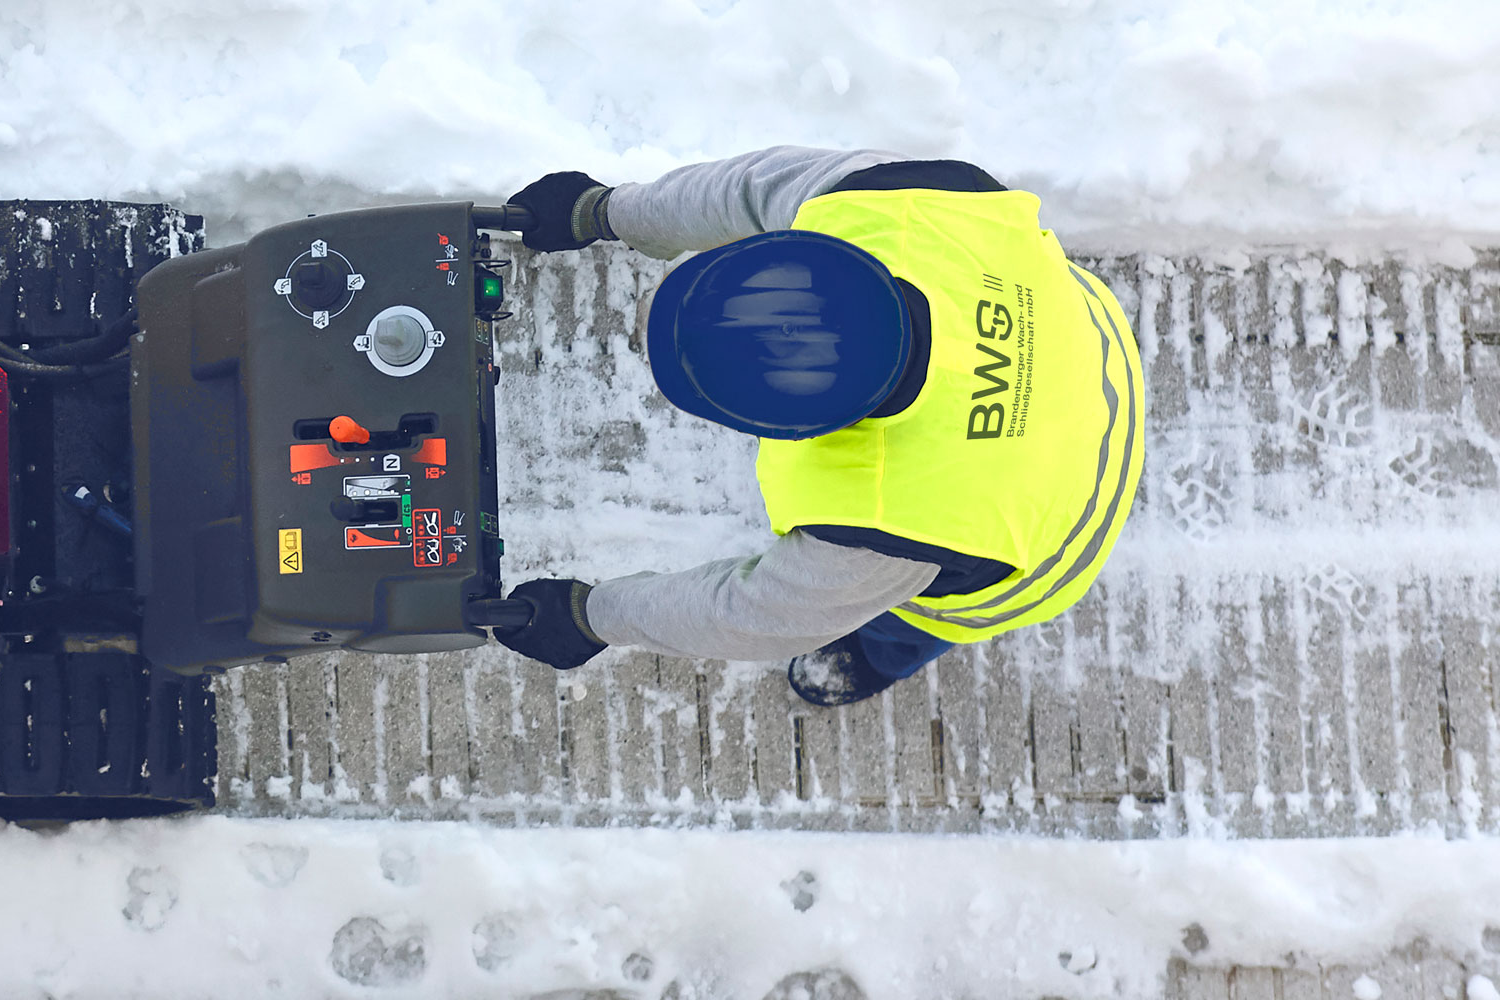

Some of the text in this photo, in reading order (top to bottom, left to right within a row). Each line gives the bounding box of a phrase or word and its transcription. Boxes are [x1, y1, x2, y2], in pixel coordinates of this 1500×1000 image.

[1006, 283, 1025, 438] Brandenburger Wach- und
[1016, 287, 1034, 438] Schließgesellschaft mbH
[386, 458, 398, 469] N
